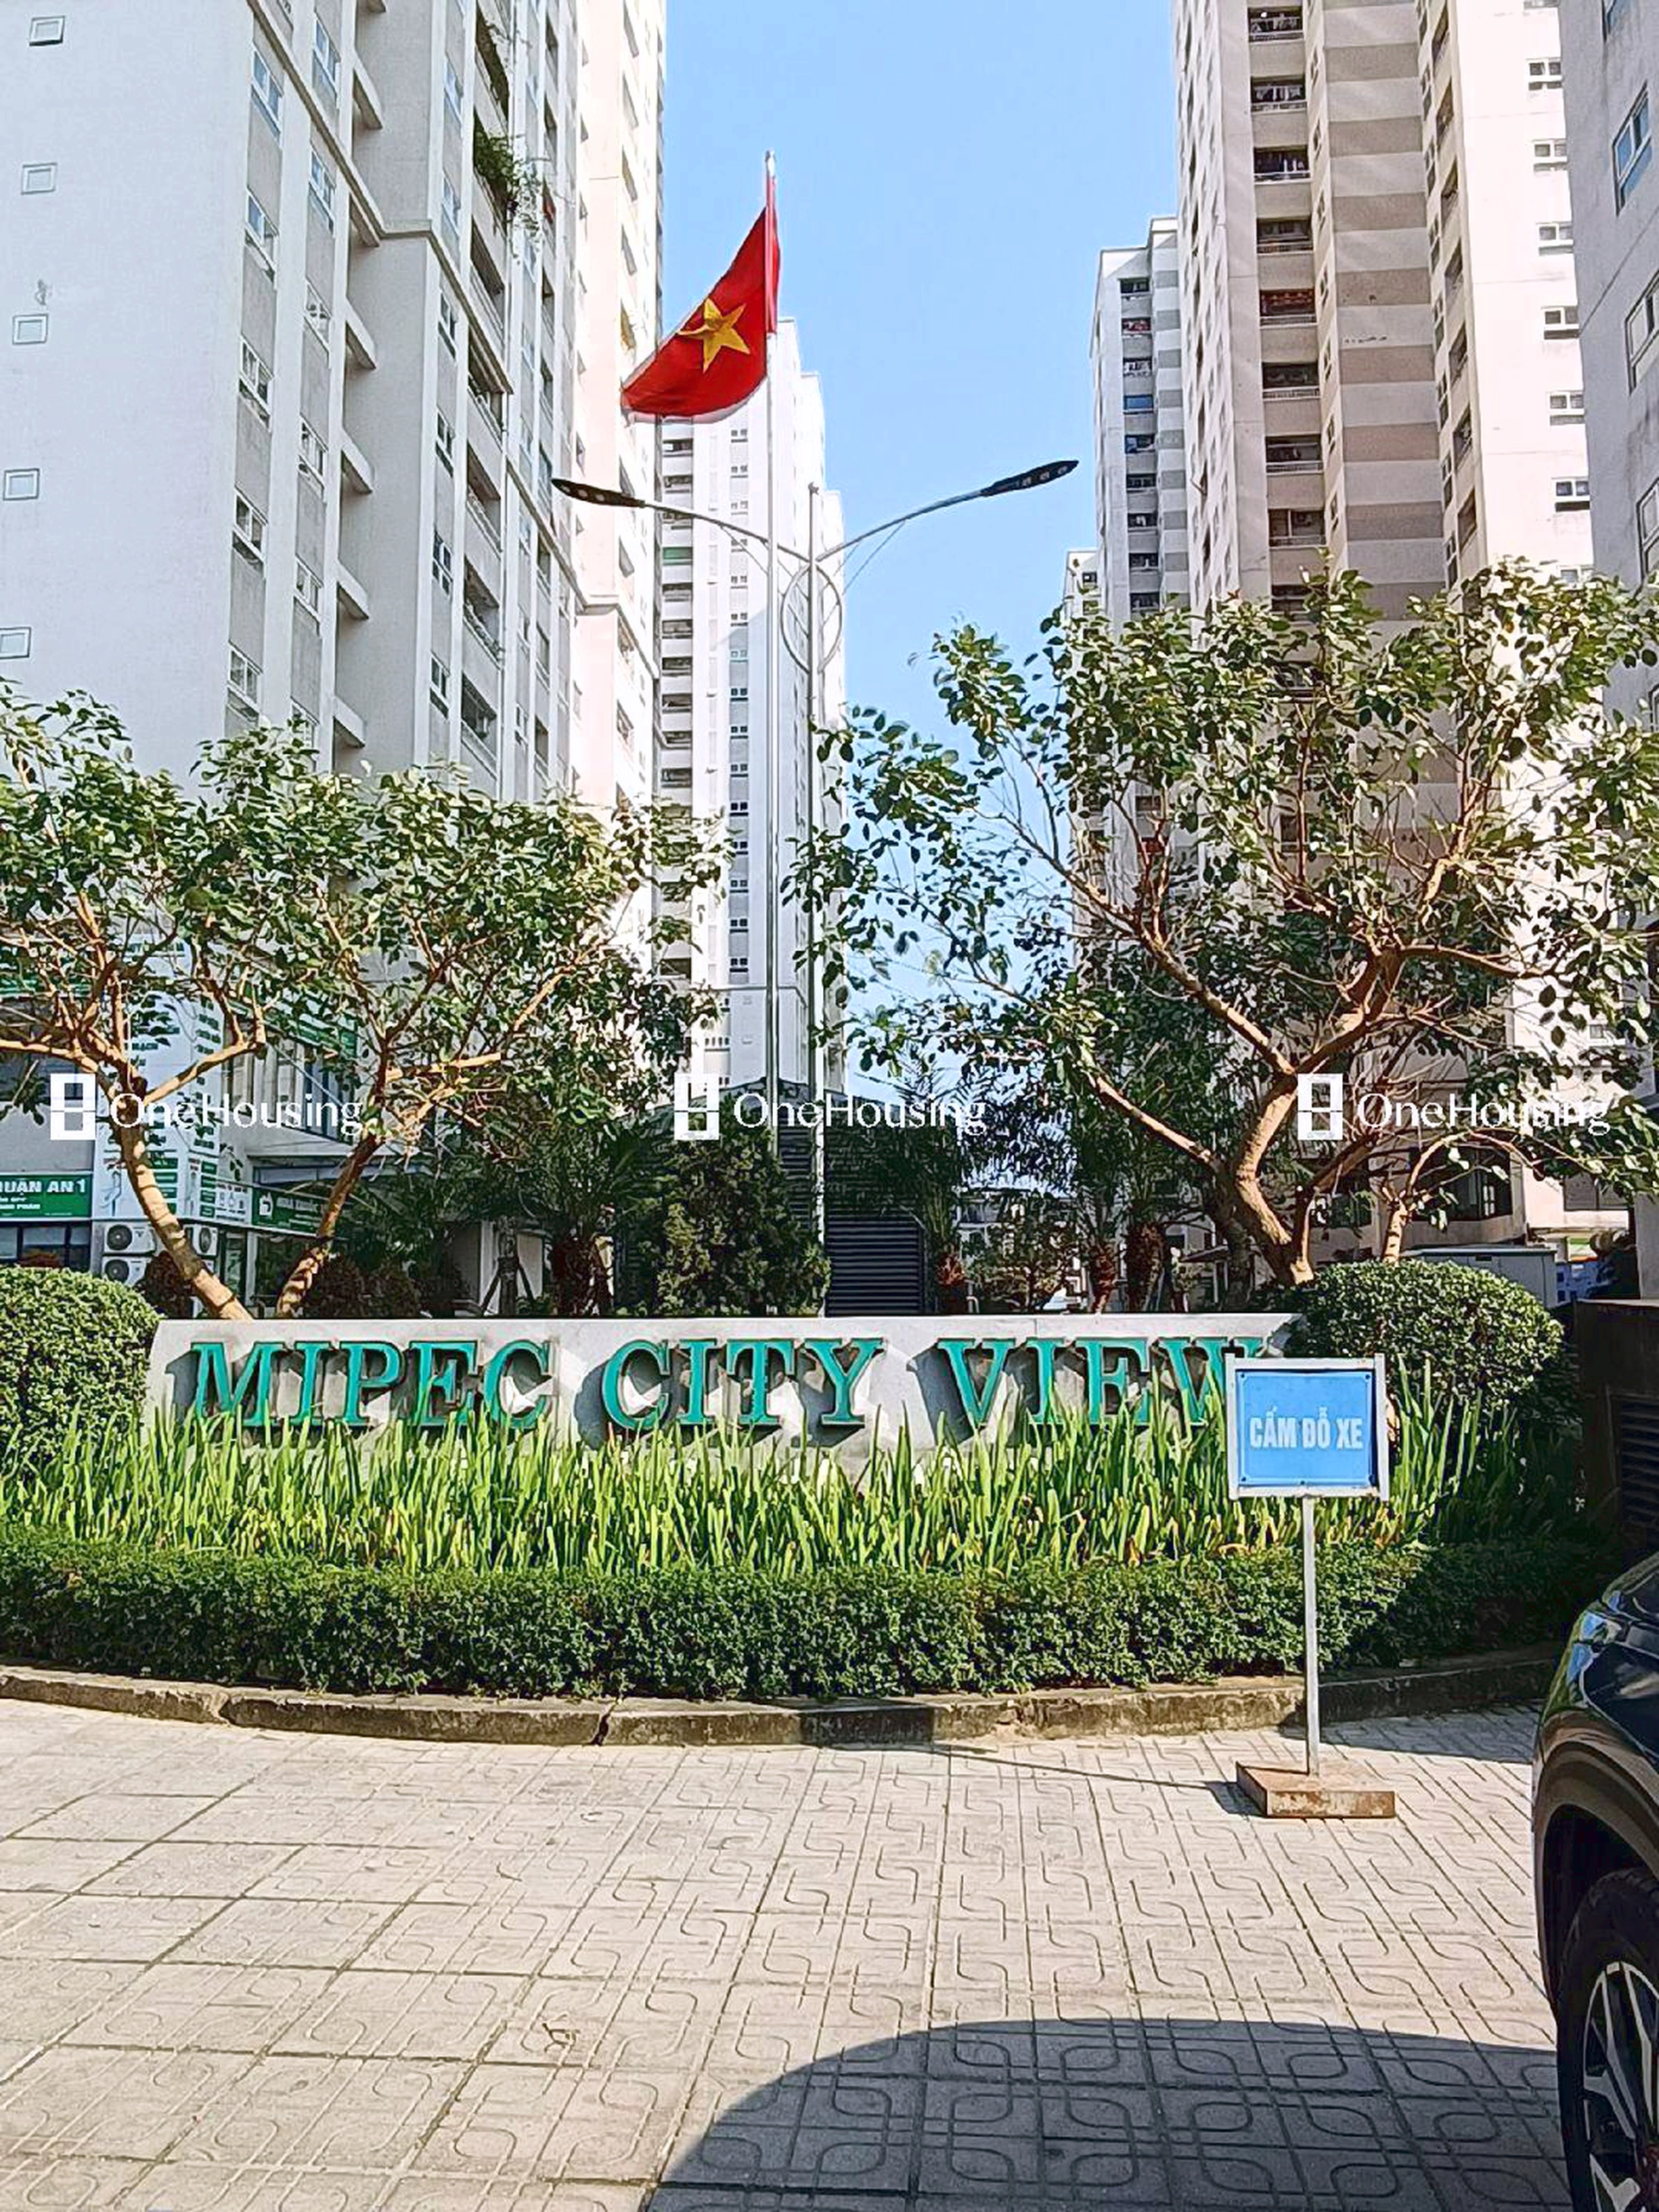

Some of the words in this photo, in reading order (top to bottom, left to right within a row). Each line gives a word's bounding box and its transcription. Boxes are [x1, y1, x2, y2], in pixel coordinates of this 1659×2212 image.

[0, 1178, 41, 1196] UẬN
[189, 1341, 553, 1428] MIPEC
[602, 1338, 885, 1430] CITY
[1249, 1405, 1296, 1449] CẤM
[1336, 1417, 1364, 1449] XE
